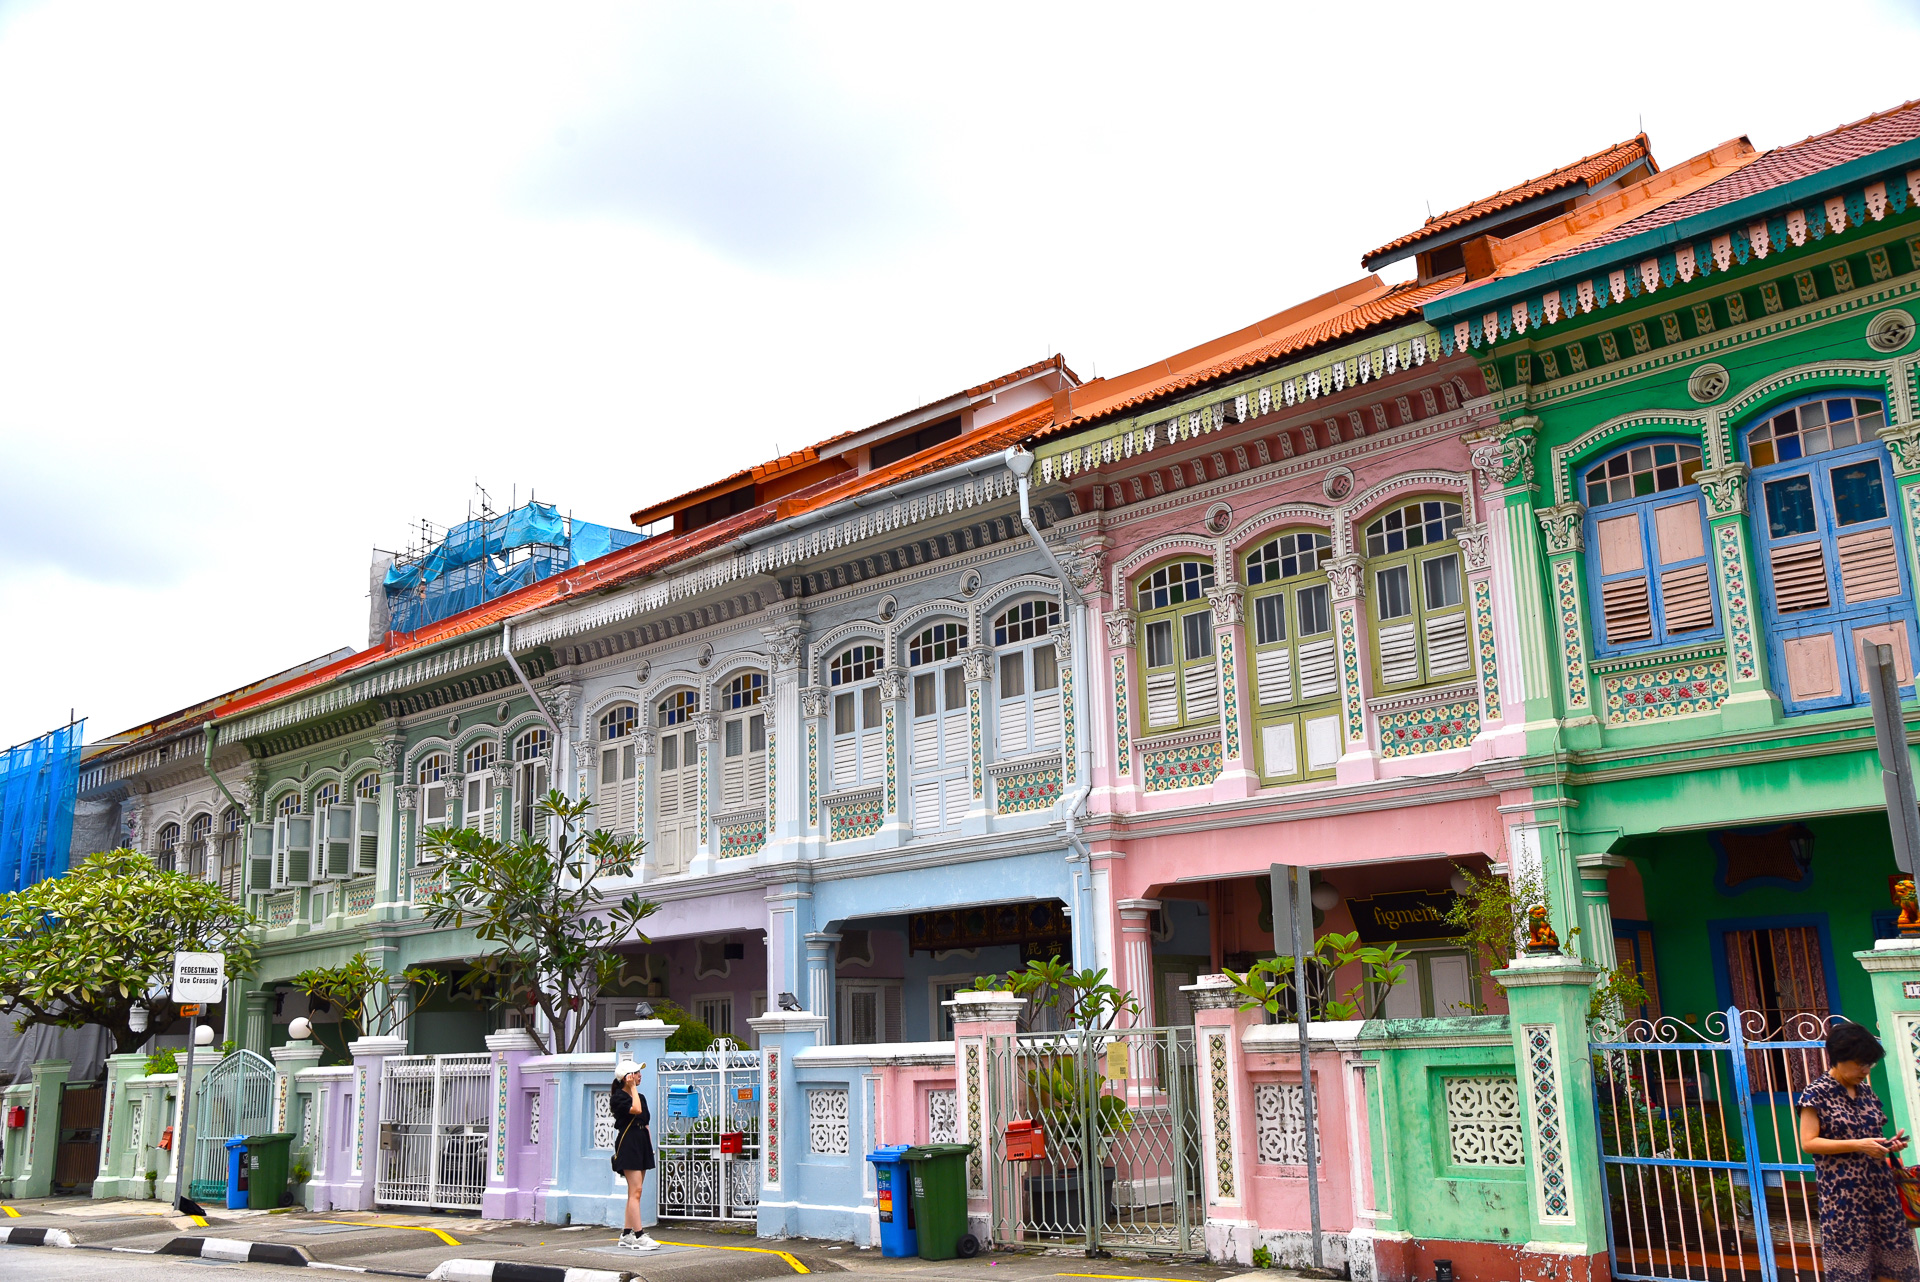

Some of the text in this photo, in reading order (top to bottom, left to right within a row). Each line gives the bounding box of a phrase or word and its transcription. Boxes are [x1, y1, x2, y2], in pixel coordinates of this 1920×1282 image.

[1374, 906, 1441, 930] figment
[180, 966, 219, 974] PEDESTRIANS
[180, 976, 218, 985] Use Crossing
